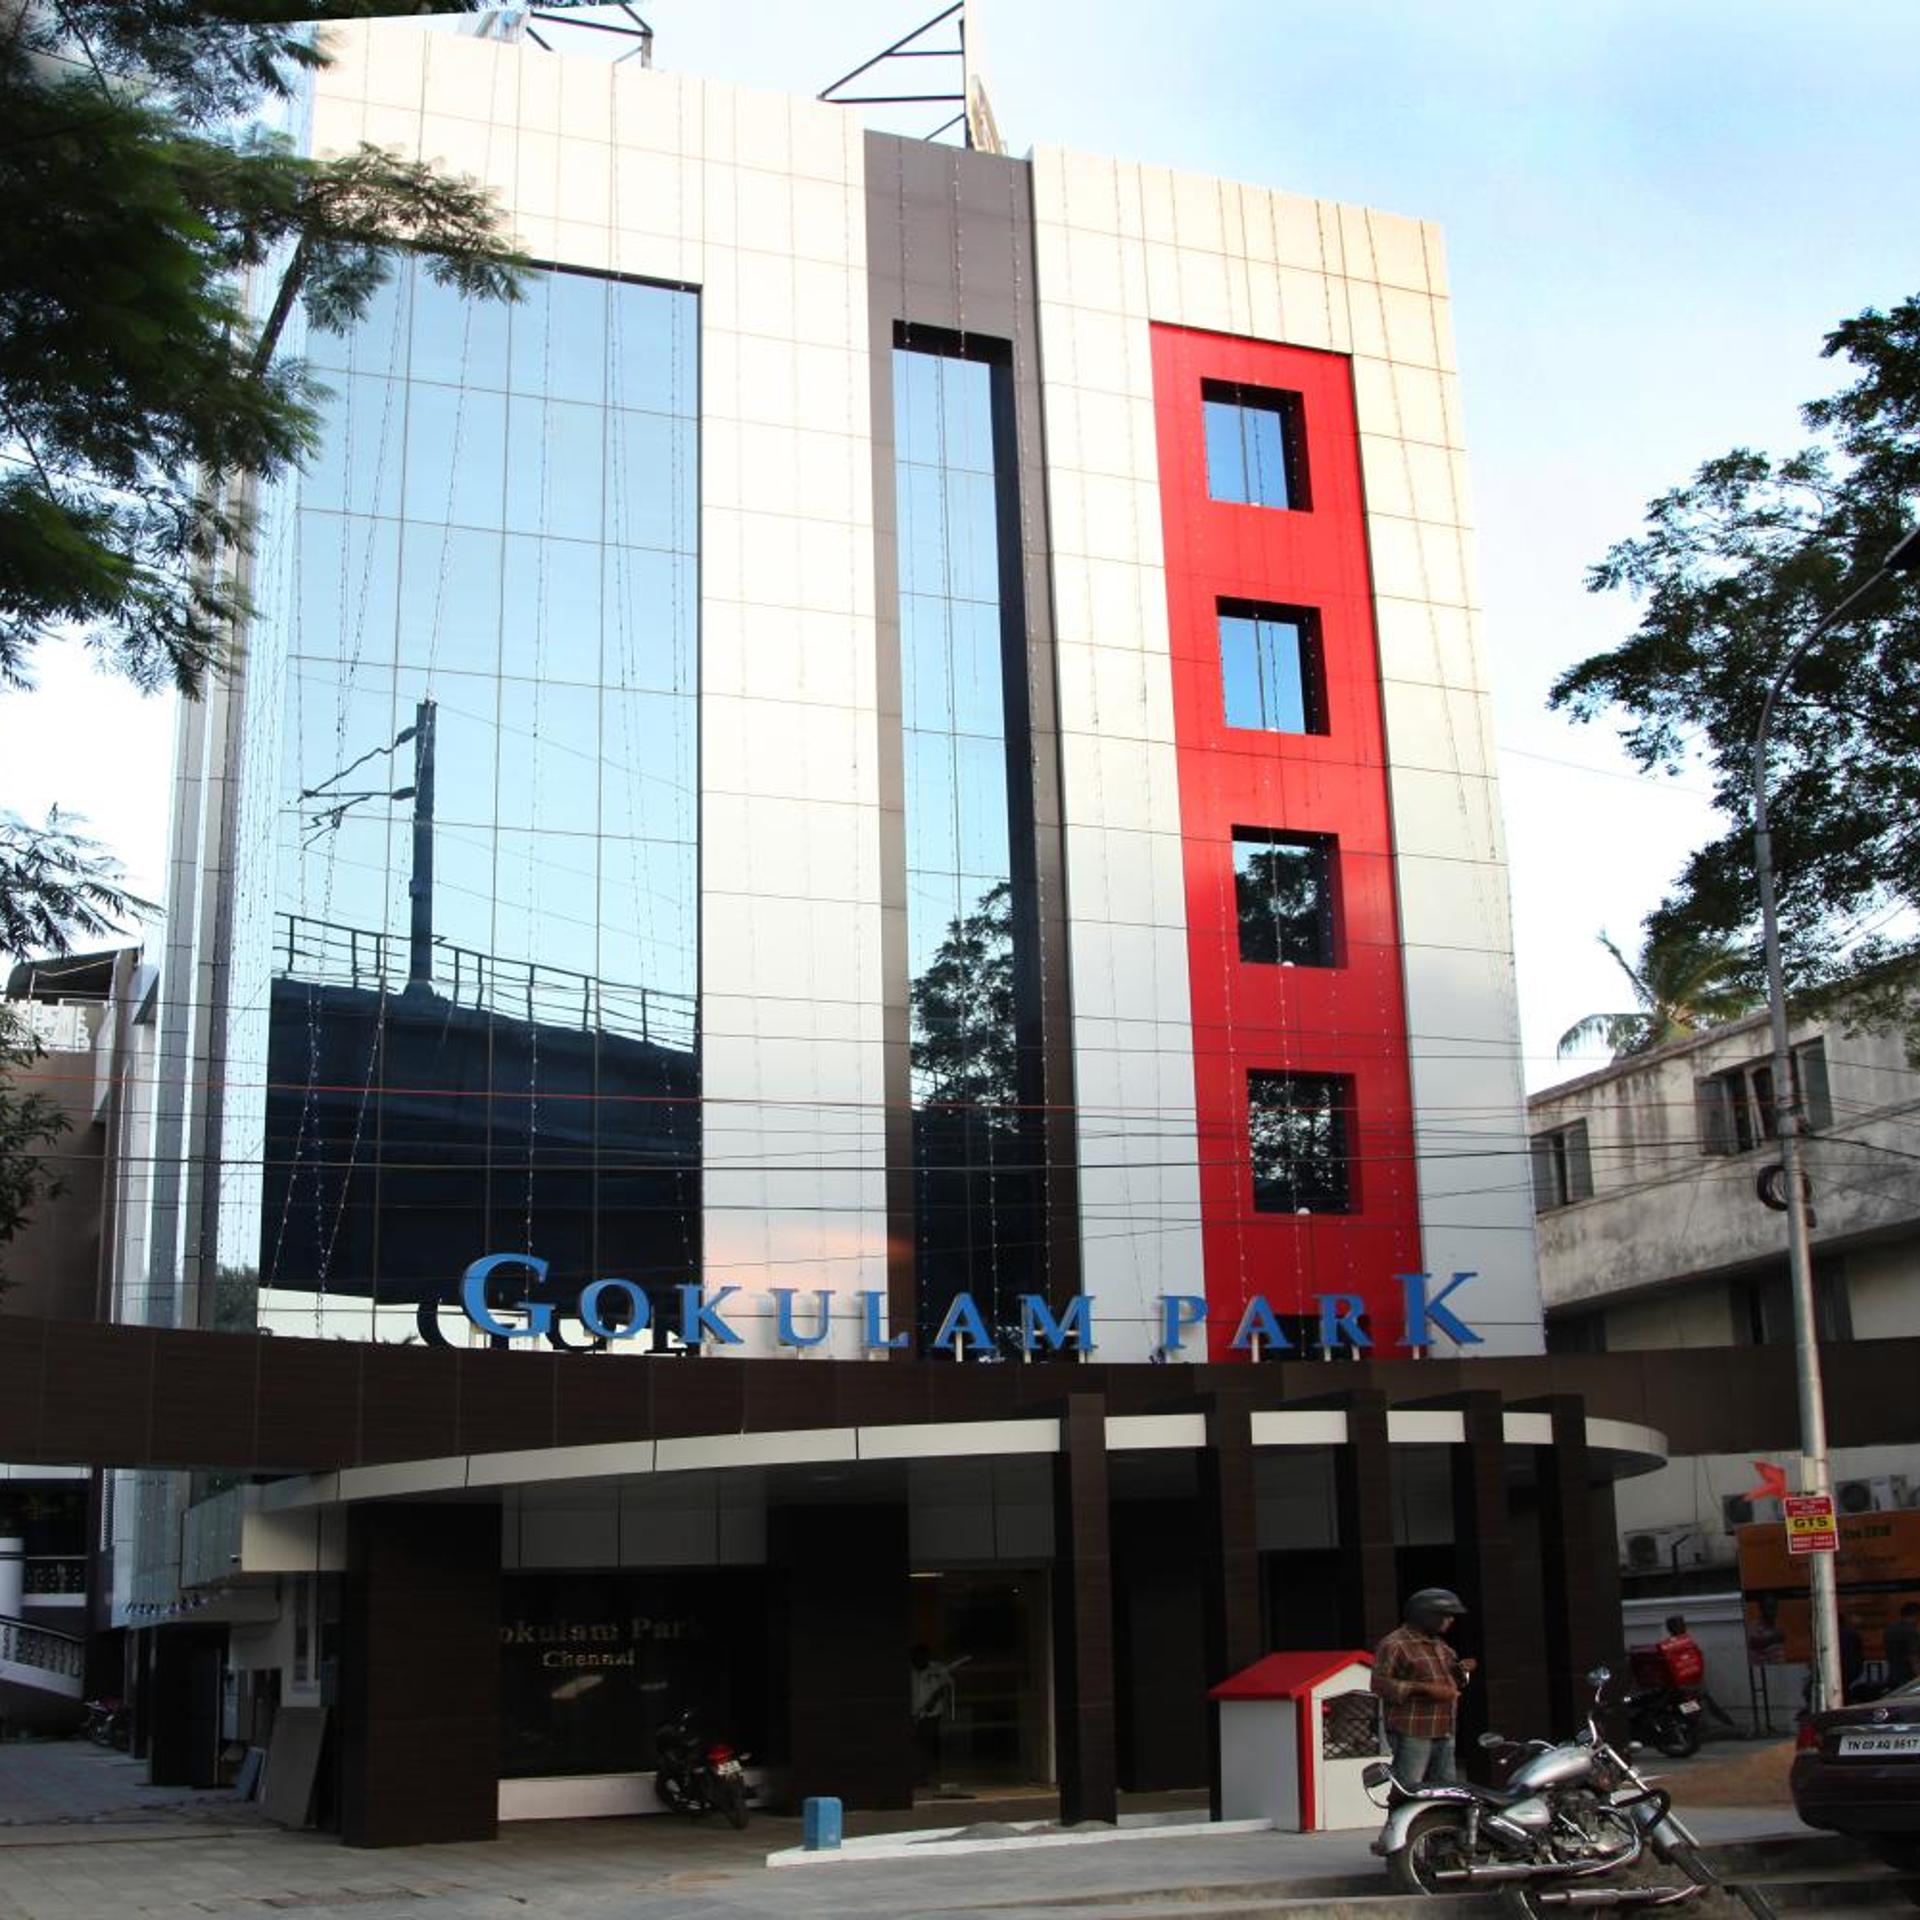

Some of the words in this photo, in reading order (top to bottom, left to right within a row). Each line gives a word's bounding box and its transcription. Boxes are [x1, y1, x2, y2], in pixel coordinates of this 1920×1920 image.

[459, 1252, 1096, 1352] GOKULAM
[1157, 1271, 1485, 1351] PARK
[1793, 1516, 1828, 1529] GTS
[498, 1617, 619, 1645] okulam
